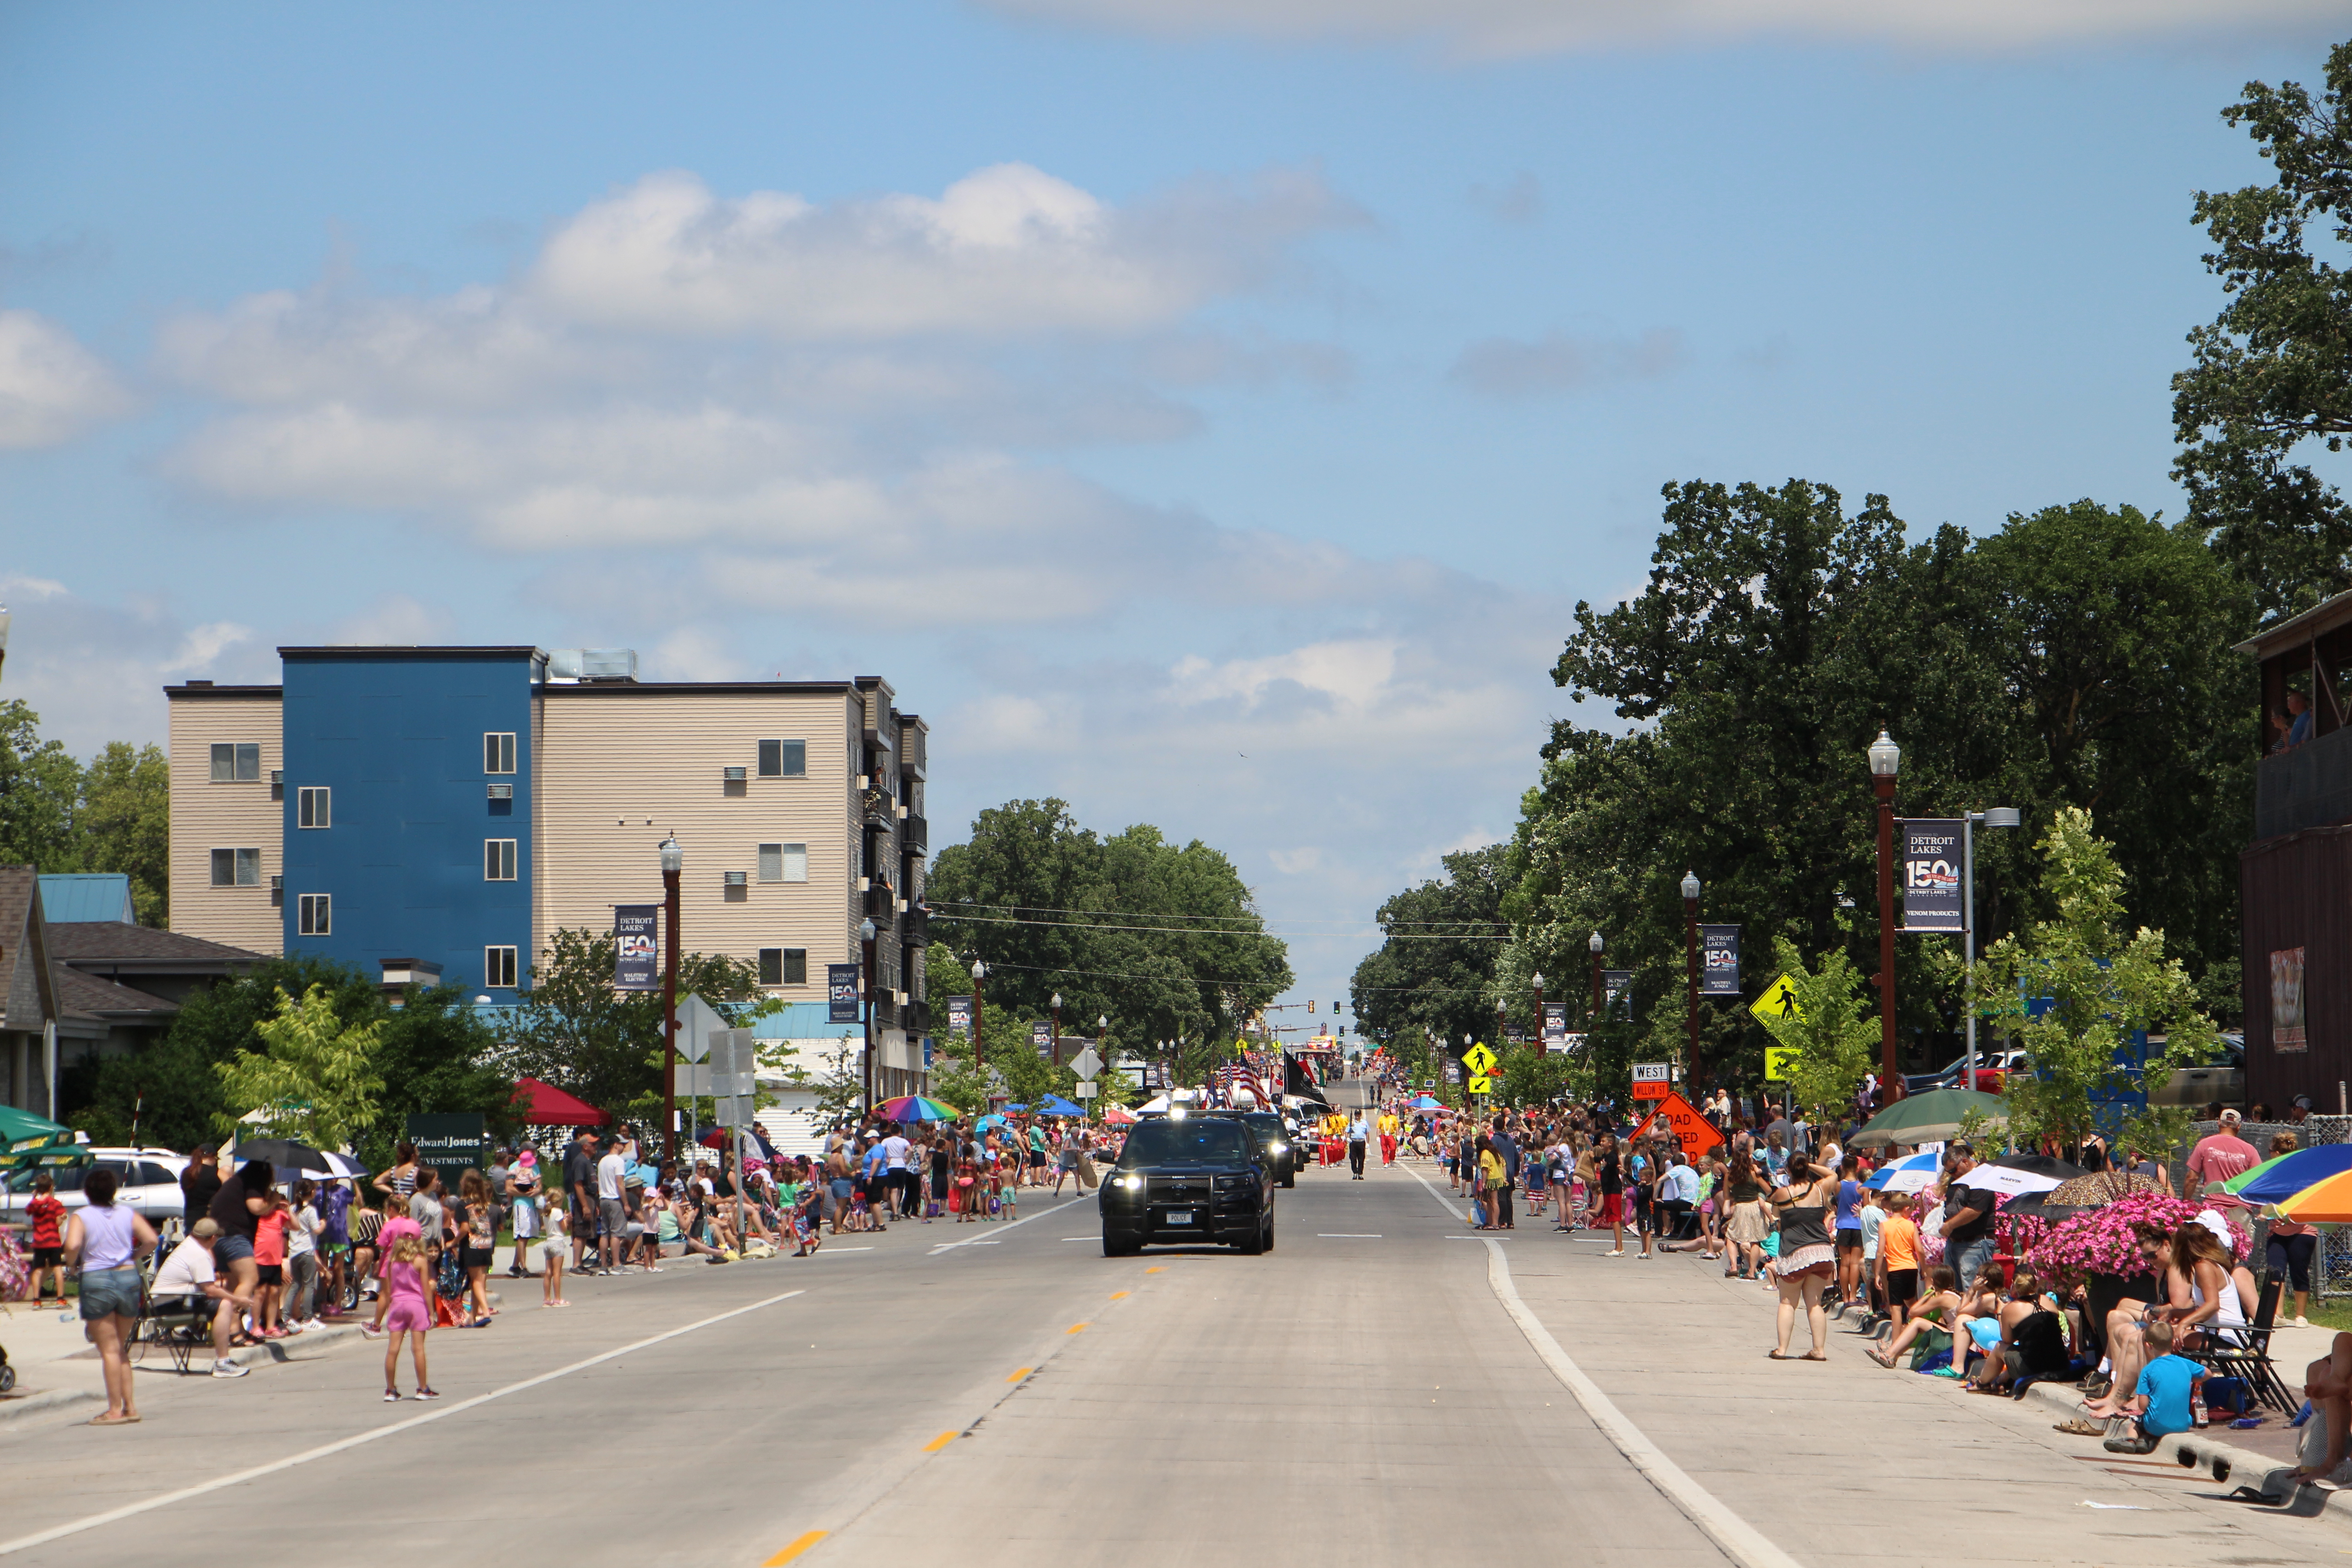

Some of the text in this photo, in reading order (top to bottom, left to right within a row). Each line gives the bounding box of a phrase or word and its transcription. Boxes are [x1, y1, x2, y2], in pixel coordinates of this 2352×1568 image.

[1911, 846, 1942, 854] LAKES
[1906, 860, 1950, 887] 150
[617, 935, 650, 956] 150
[1705, 950, 1732, 967] 150
[830, 985, 853, 1000] 150
[949, 1012, 966, 1024] 150
[1546, 1018, 1562, 1027] 150
[1034, 1034, 1048, 1043] 150
[1637, 1067, 1664, 1078] WEST
[1637, 1085, 1665, 1095] WILLOW ST
[1666, 1114, 1690, 1125] OAD
[10, 1136, 49, 1153] SUBWAY
[411, 1136, 480, 1148] Edward Jones
[0, 1156, 20, 1165] WAY
[39, 1156, 74, 1165] SUBWAY
